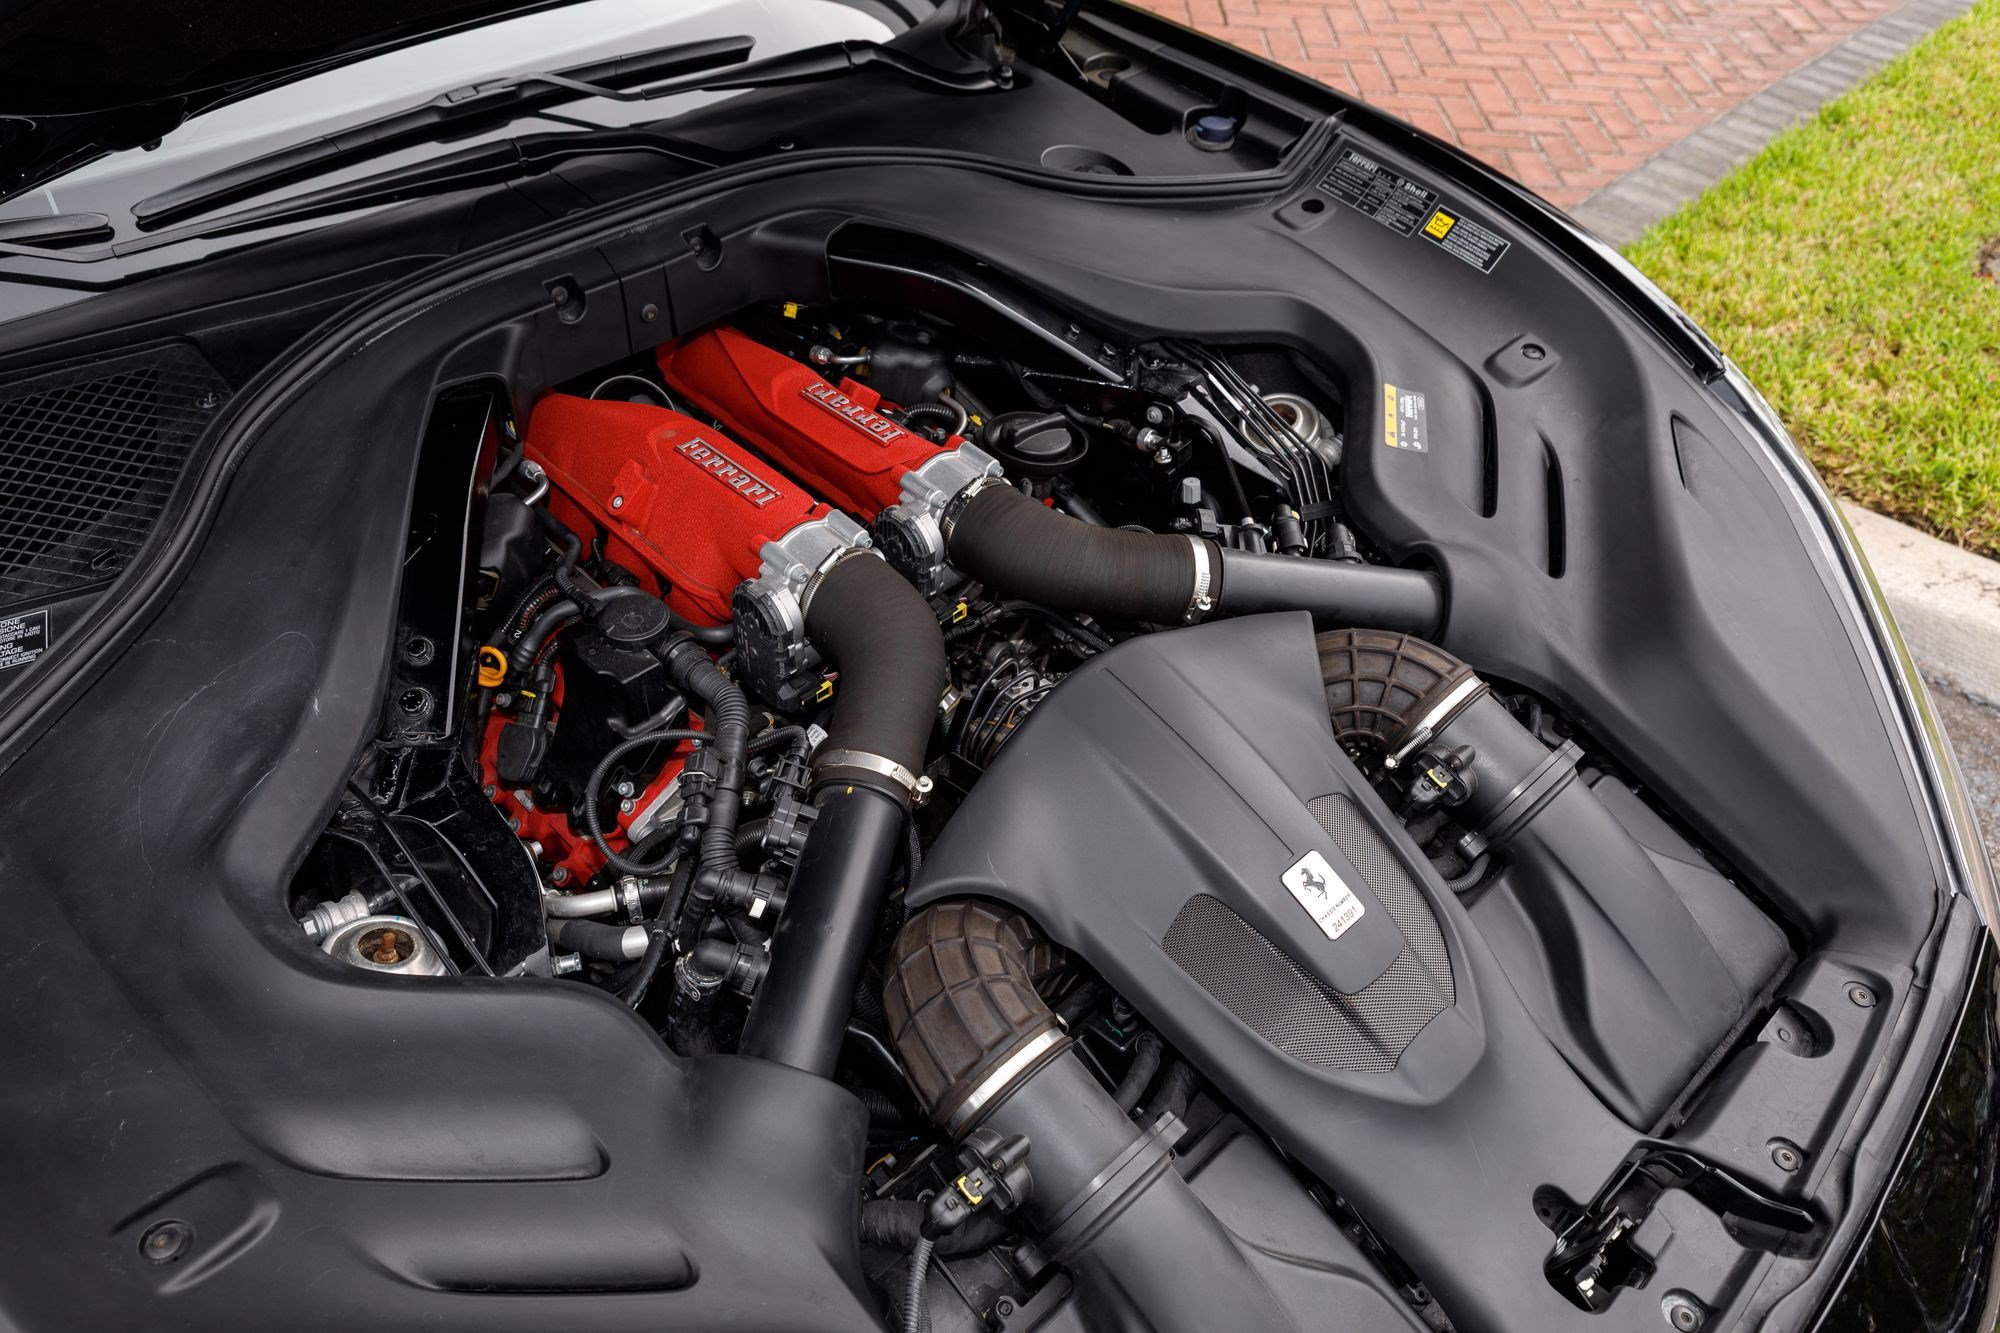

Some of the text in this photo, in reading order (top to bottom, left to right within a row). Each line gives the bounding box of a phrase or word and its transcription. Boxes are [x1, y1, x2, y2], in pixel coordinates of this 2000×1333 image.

[1404, 182, 1428, 199] Shell
[801, 381, 906, 445] Ferrari
[675, 437, 782, 506] Ferrari
[1332, 905, 1357, 932] 241391
